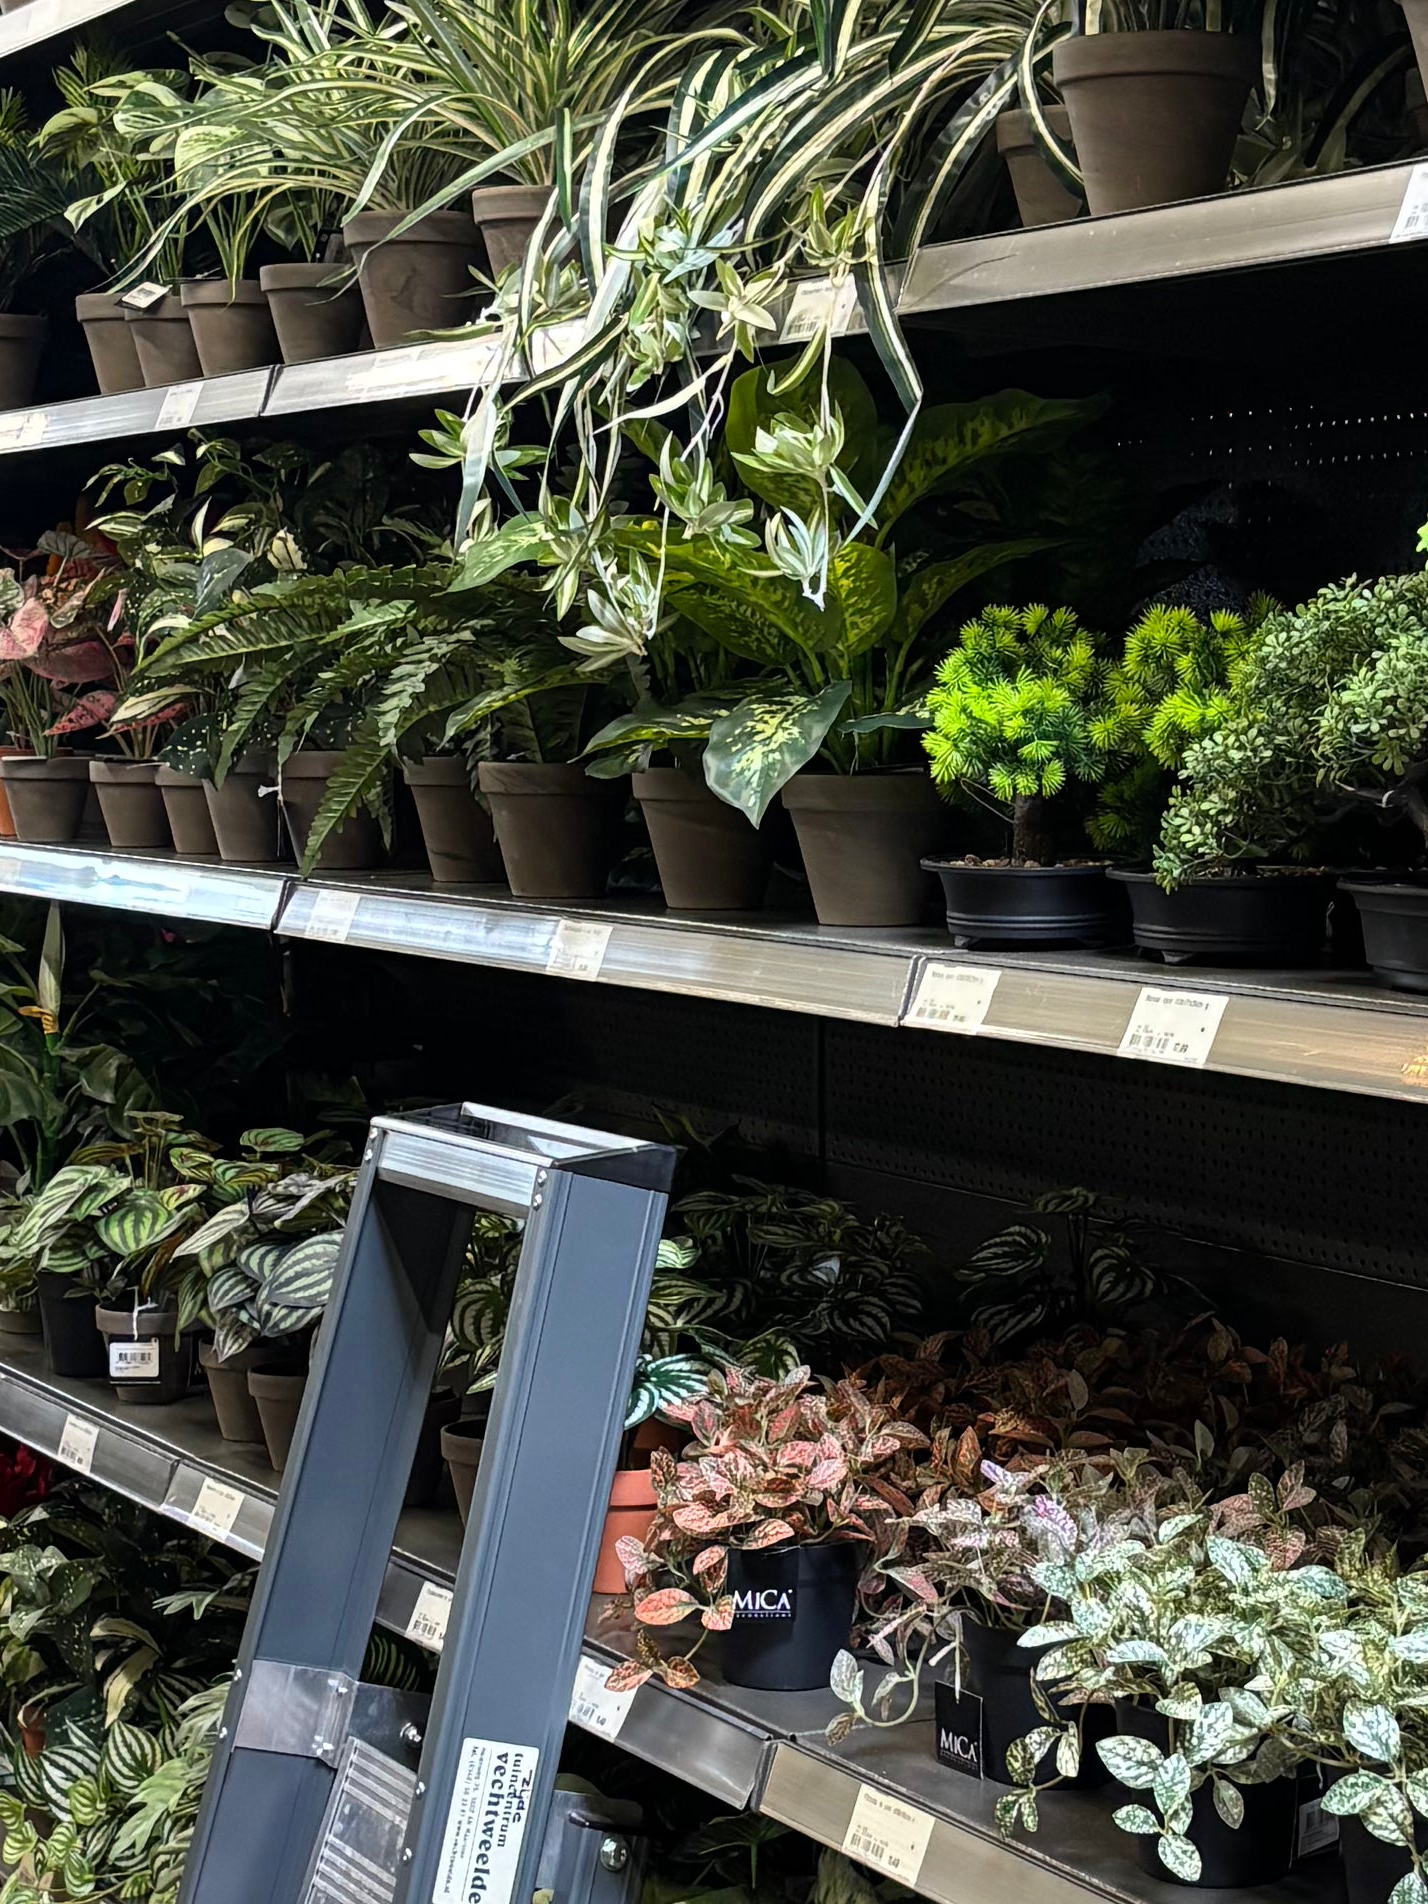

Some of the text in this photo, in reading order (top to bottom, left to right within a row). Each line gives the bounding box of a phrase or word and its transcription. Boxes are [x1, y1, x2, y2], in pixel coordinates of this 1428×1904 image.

[732, 1589, 791, 1610] MICA
[940, 1727, 977, 1762] MICA
[468, 1752, 509, 1904] vechtweelde
